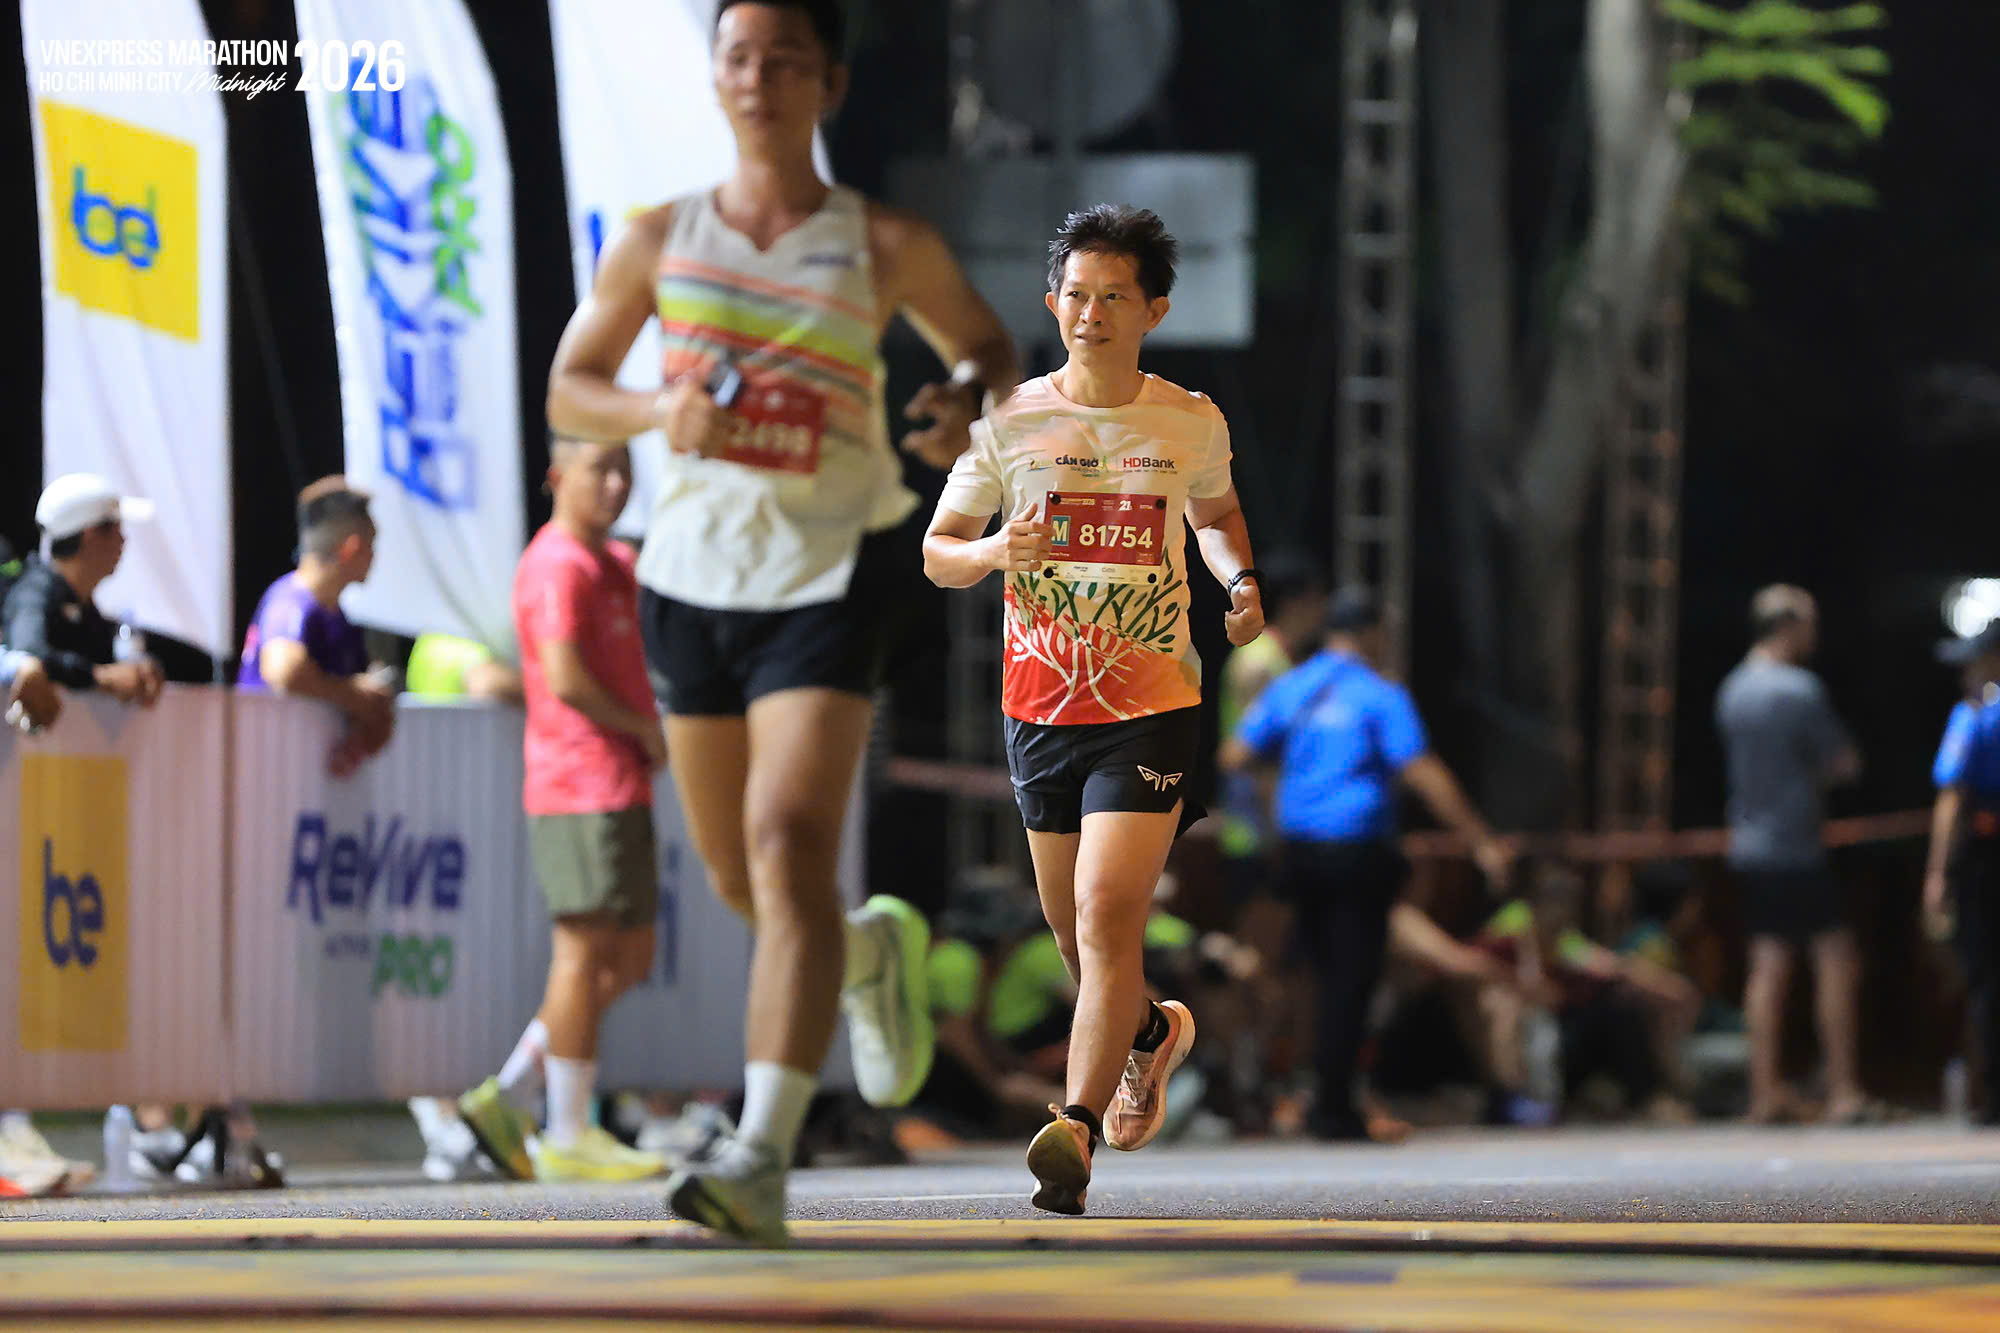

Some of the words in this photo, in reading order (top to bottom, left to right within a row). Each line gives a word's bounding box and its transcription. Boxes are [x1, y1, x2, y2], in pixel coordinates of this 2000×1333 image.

[1123, 457, 1175, 469] HDBank
[1051, 520, 1068, 542] M
[1079, 523, 1153, 549] 81754
[43, 837, 105, 967] be
